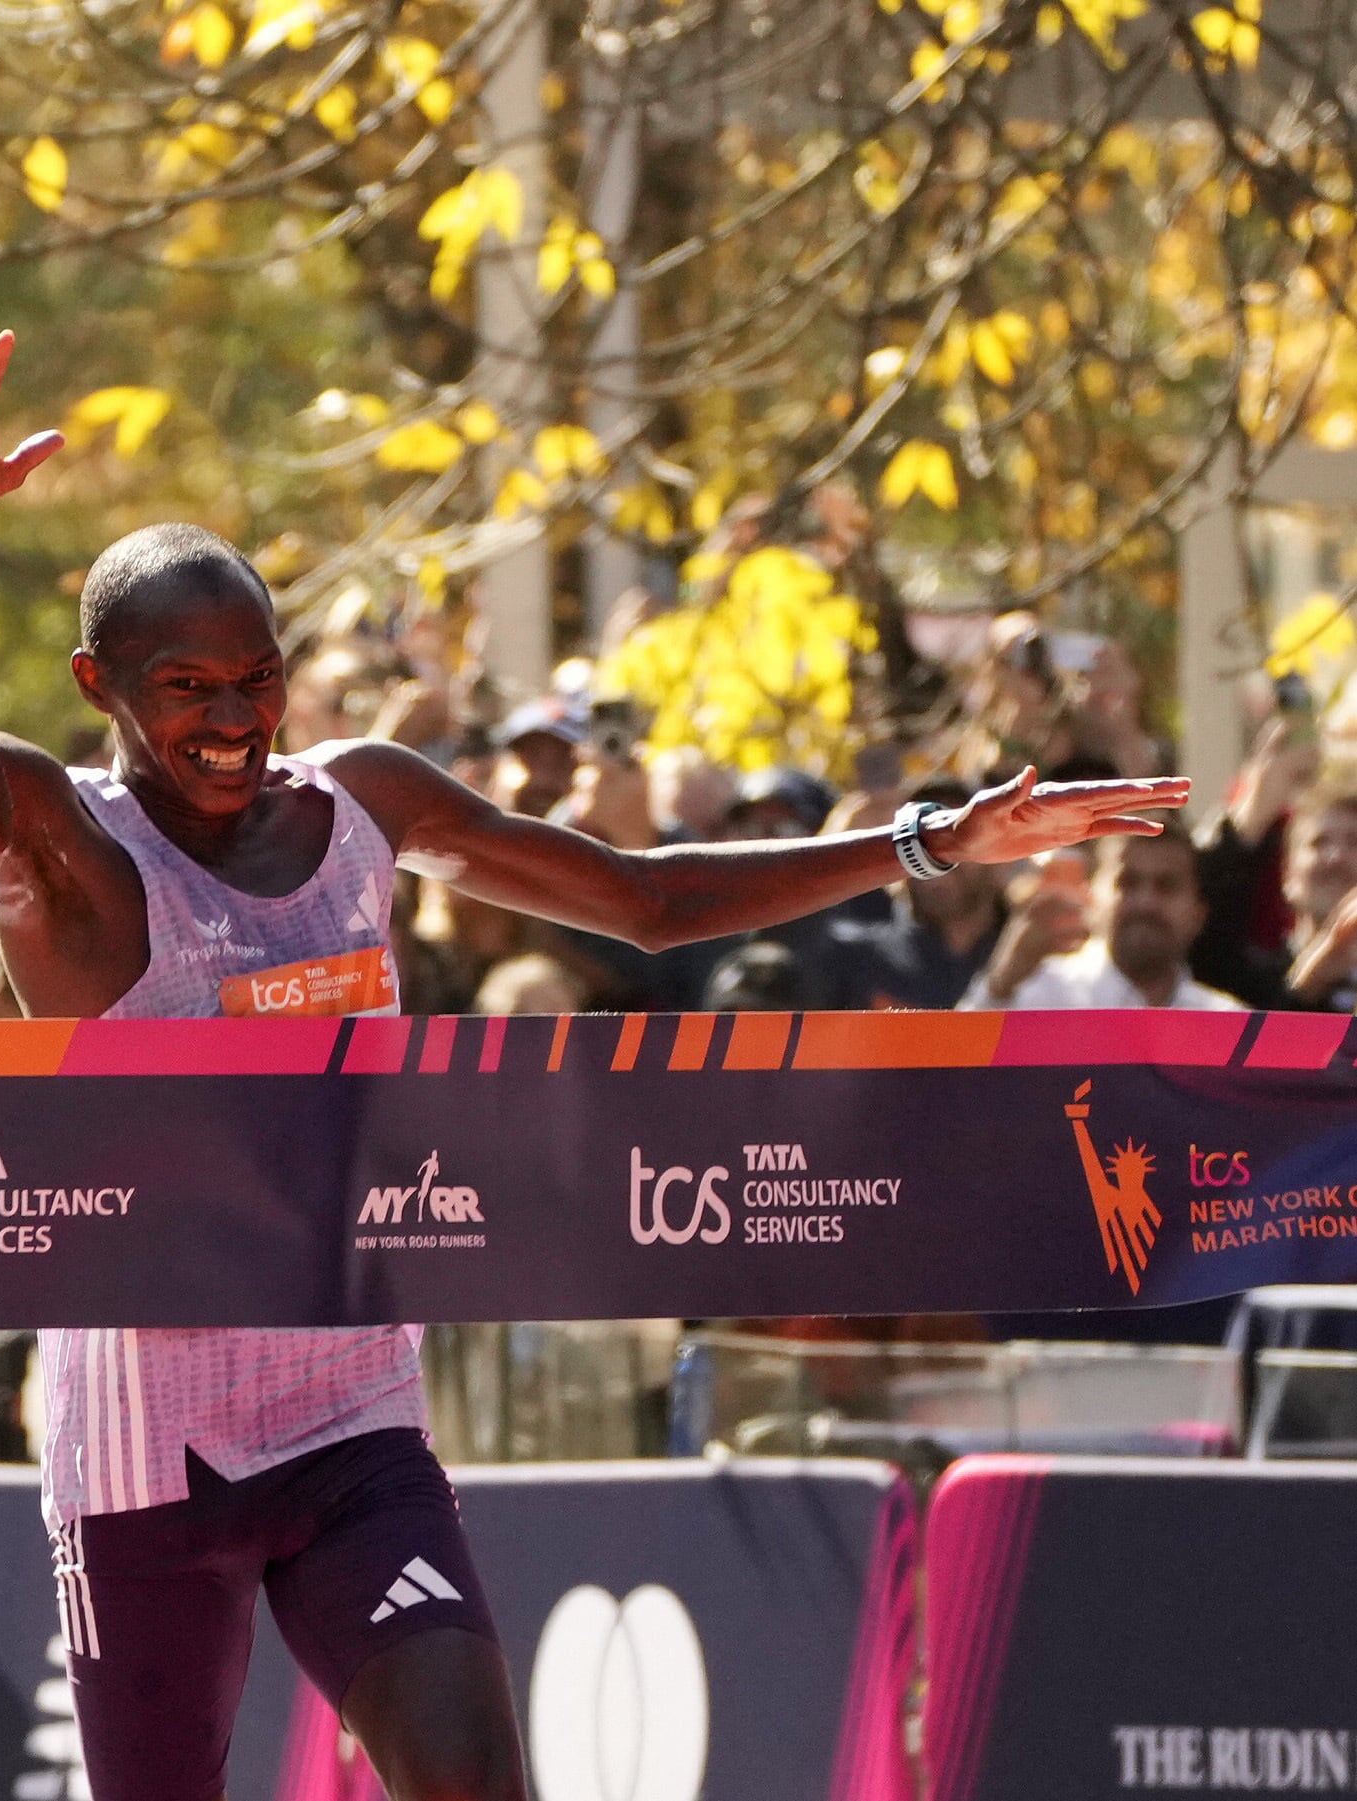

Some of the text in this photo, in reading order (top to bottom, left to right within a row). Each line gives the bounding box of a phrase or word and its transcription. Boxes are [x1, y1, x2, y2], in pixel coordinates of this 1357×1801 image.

[250, 978, 305, 1012] tcs
[743, 1144, 807, 1171] TATA
[1190, 1144, 1251, 1186] tcs
[631, 1147, 731, 1245] tcs
[744, 1178, 901, 1207] CONSULTANCY
[1190, 1198, 1254, 1223] NEW
[1262, 1185, 1342, 1213] YORK
[355, 1234, 486, 1249] NEW YORK ROAD RUNNERS
[744, 1215, 844, 1244] SERVICES
[1192, 1215, 1357, 1253] MARATHON
[1114, 1726, 1348, 1790] THE RUDIN
